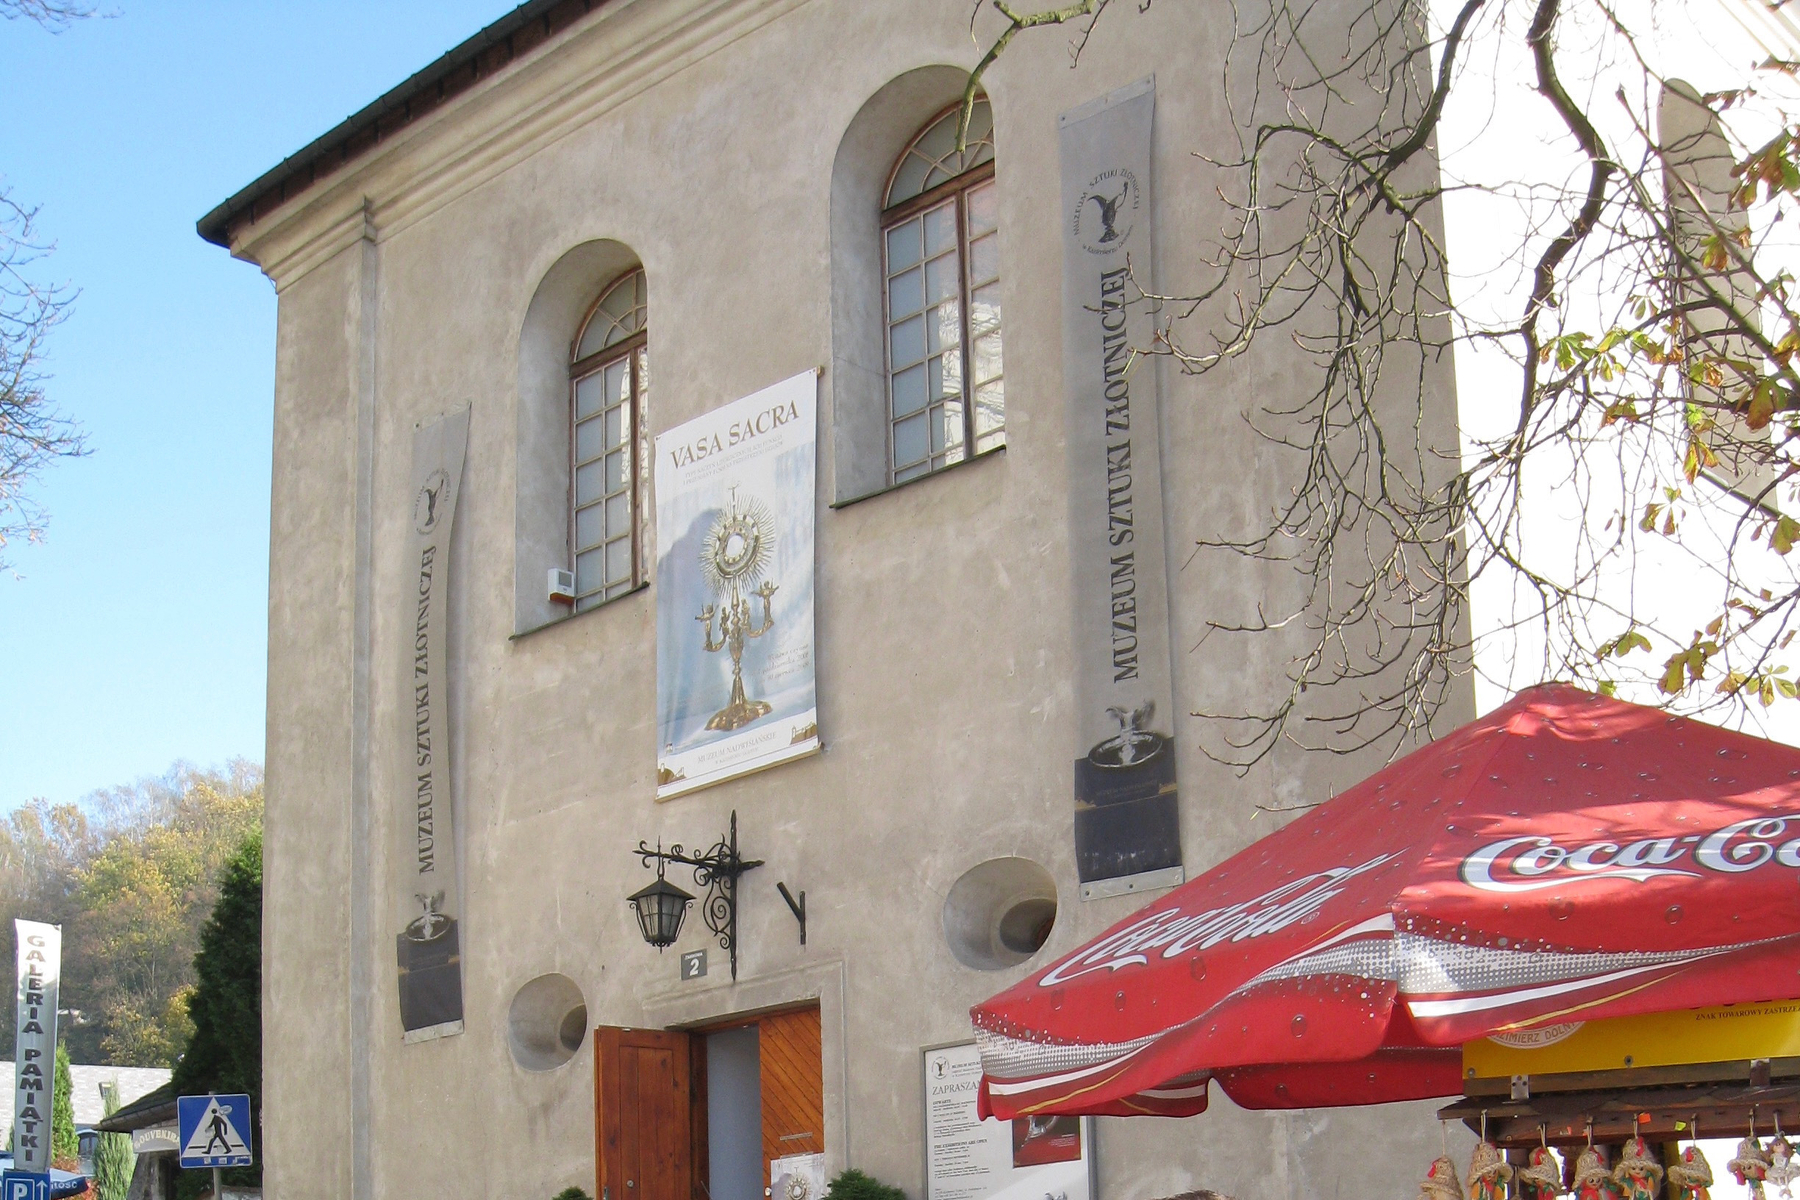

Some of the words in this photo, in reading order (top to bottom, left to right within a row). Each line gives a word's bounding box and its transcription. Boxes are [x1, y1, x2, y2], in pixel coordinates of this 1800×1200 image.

[1072, 192, 1088, 236] MUZEUM
[1089, 168, 1118, 189] SZTUKI
[1100, 267, 1132, 436] ZŁOTNICZEJ
[670, 432, 724, 469] VASA
[728, 399, 799, 447] SACRA
[1106, 438, 1134, 547] SZTUKI
[414, 545, 436, 679] ZŁOTNICZEJ
[1109, 551, 1139, 684] MUZEUM
[415, 682, 431, 766] SZTUKI
[416, 771, 435, 877] MUZEUM
[689, 958, 700, 976] 2
[1038, 847, 1410, 988] Coca-Cola
[23, 935, 45, 1034] GALERIA
[1695, 1013, 1717, 1021] ZNAK
[1718, 1009, 1762, 1019] TOWAROWY
